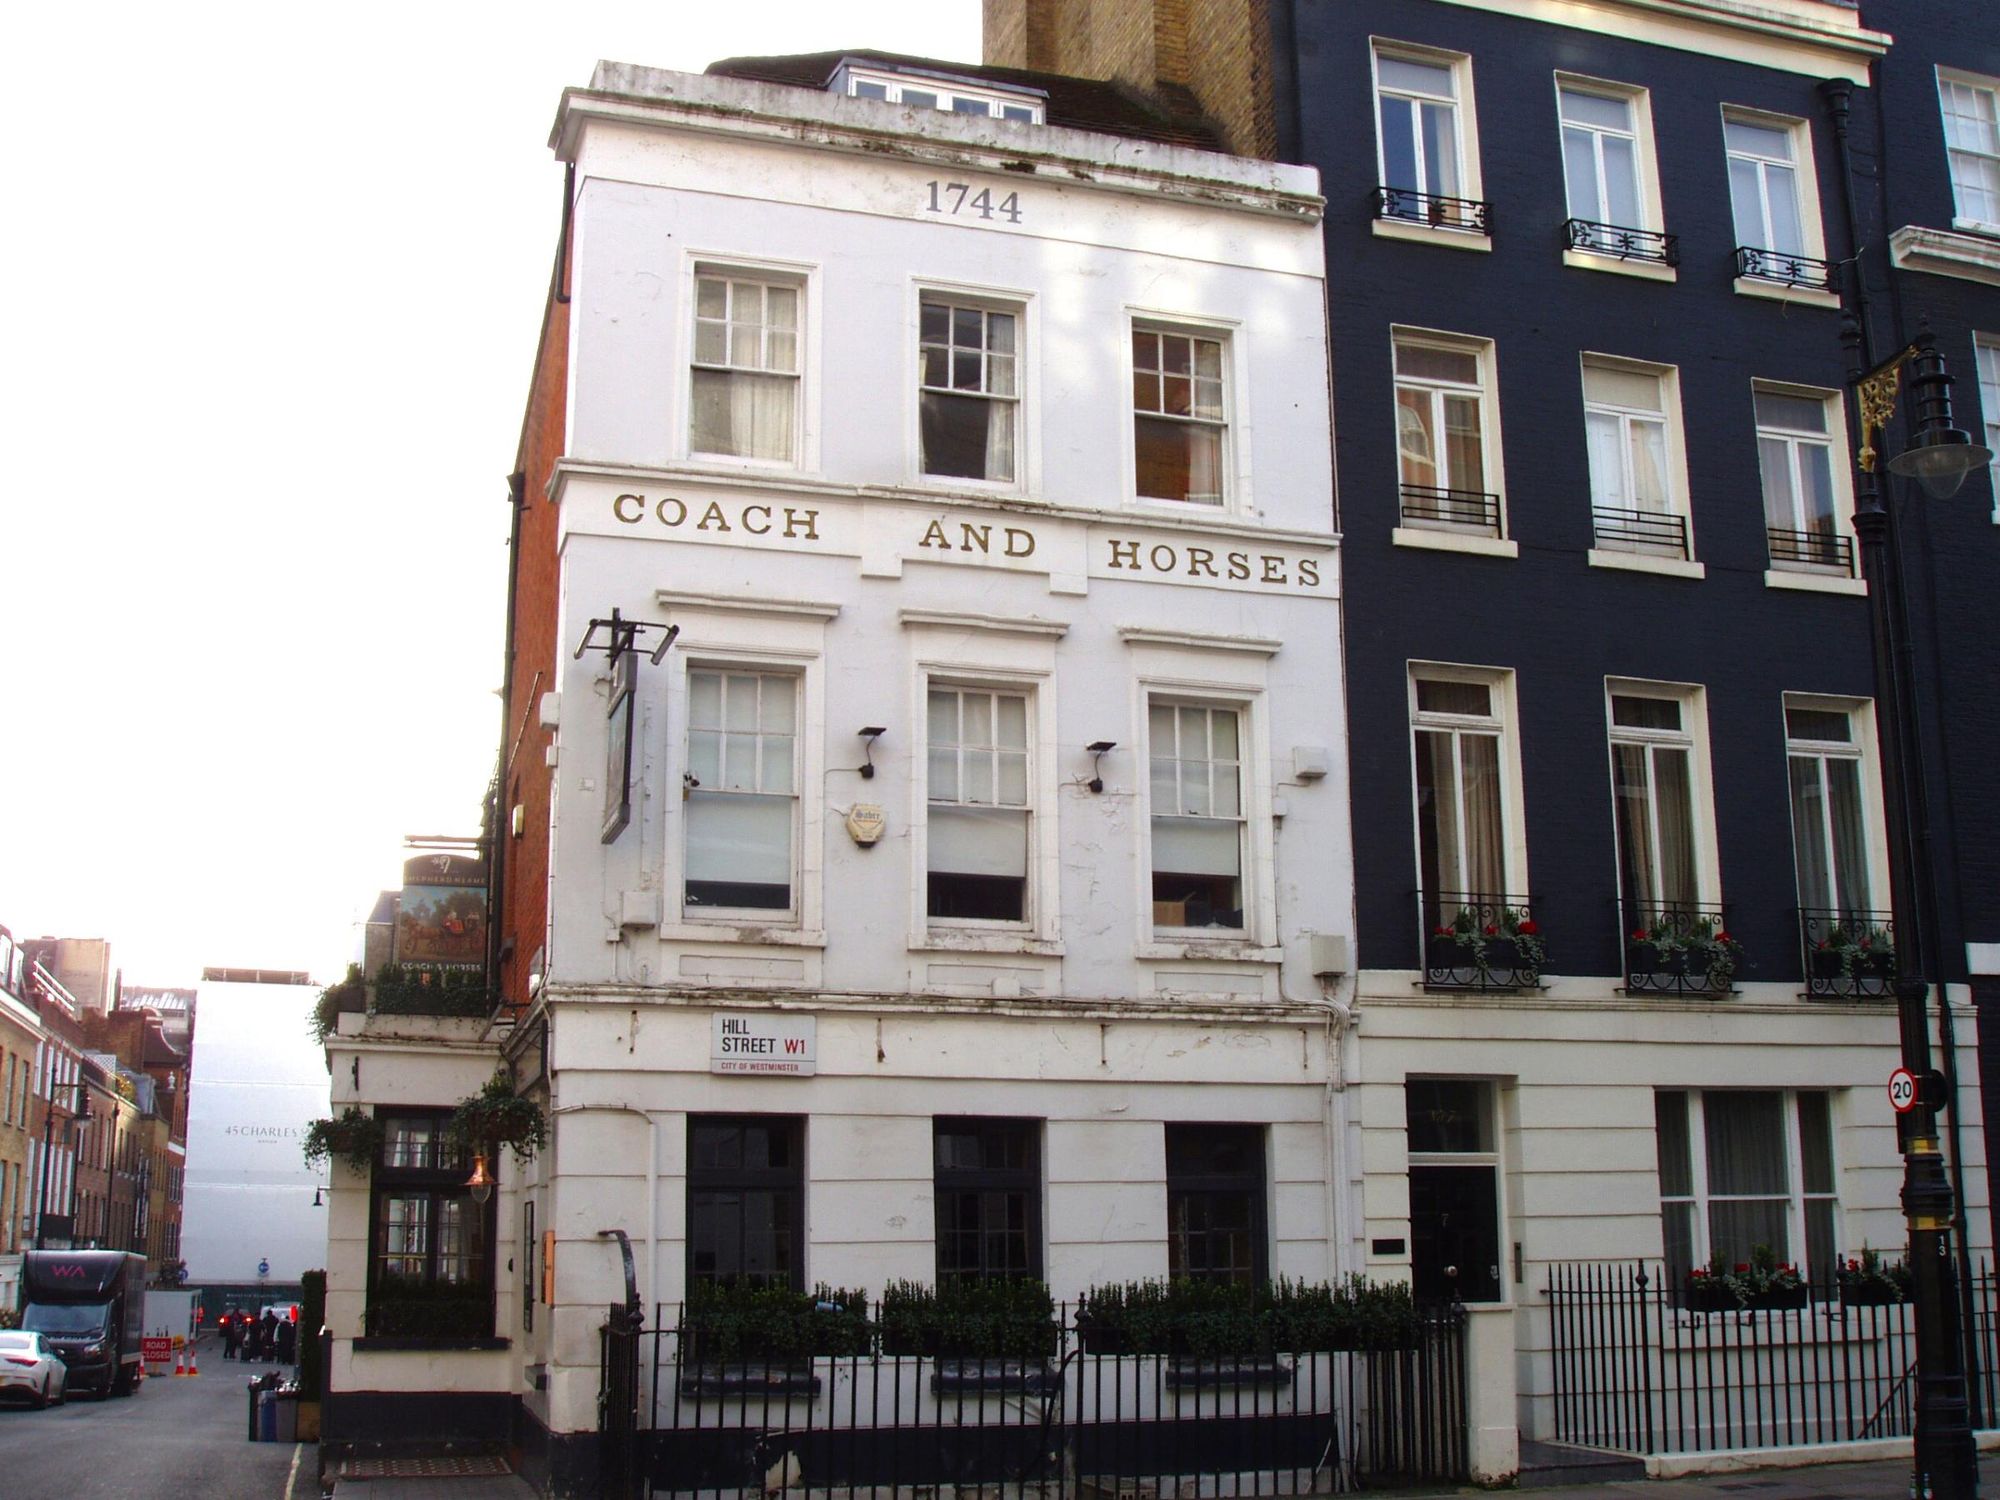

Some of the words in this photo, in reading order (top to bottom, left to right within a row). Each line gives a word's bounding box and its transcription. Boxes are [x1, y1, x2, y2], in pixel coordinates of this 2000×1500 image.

[926, 180, 1023, 224] 1744
[613, 493, 820, 540] COACH
[918, 519, 1036, 558] AND
[1107, 539, 1320, 587] HORSES
[722, 1019, 750, 1034] HILL
[722, 1037, 776, 1053] STREET
[784, 1039, 805, 1054] W1
[721, 1062, 736, 1070] CITY
[739, 1062, 747, 1070] OF
[750, 1062, 799, 1072] WESTMINSTER
[1893, 1081, 1912, 1099] 20
[146, 1341, 167, 1349] ROAD
[142, 1351, 171, 1359] CLOSED
